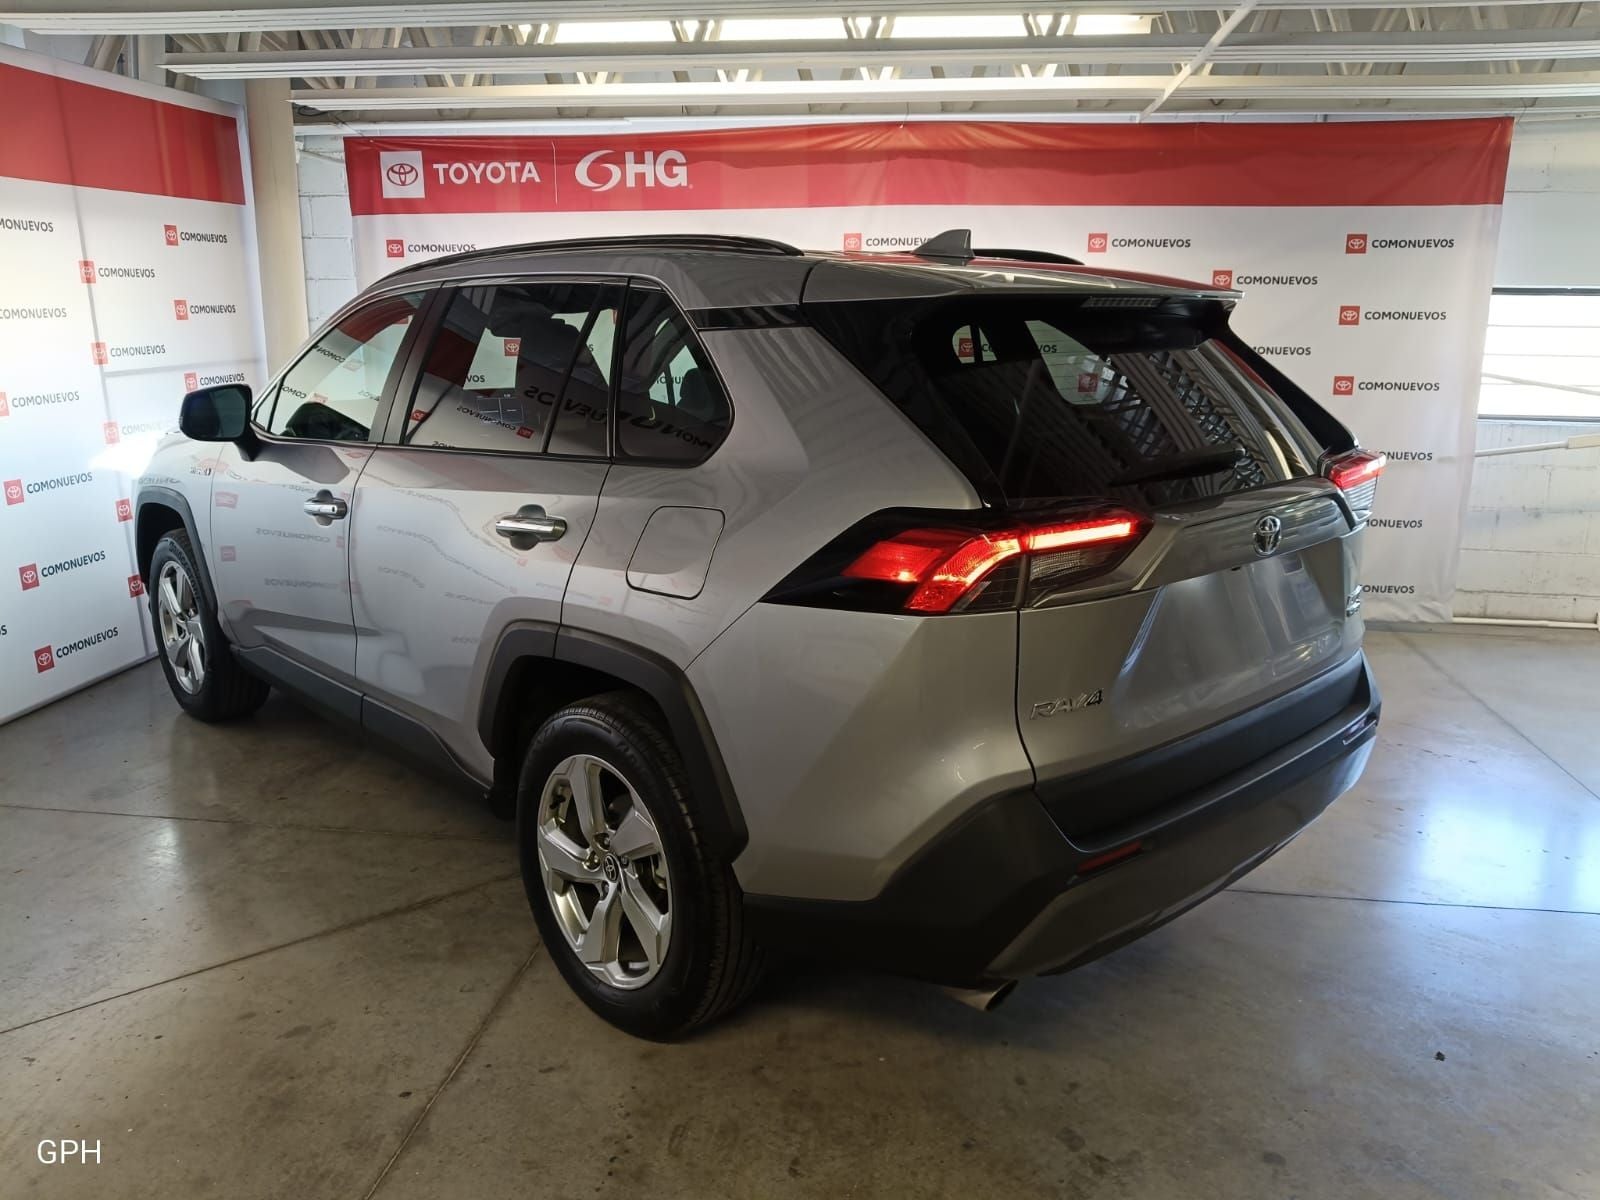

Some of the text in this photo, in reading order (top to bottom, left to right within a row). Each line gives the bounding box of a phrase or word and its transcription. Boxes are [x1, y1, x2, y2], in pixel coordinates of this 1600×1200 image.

[433, 161, 541, 185] TOYOTA
[180, 232, 227, 244] COMONUEVOS
[866, 237, 936, 247] COMONUEV
[1112, 239, 1191, 249] COMONUEVOS
[1372, 239, 1454, 249] COMONUEVOS
[408, 244, 476, 253] COMONUEVOS
[98, 267, 155, 279] COMONUEVOS
[1237, 275, 1318, 286] COMONUEVOS
[190, 304, 236, 315] COMONUEVOS
[1365, 311, 1447, 321] COMONUEVOS
[111, 345, 165, 357] COMONUEVOS
[200, 373, 245, 385] COMONUEVOS
[1358, 381, 1440, 392] COMONUEVOS
[12, 391, 80, 408] COMONUEVOS
[27, 472, 93, 494] COMONUEVOS
[42, 551, 106, 578] COMONUEVOS
[1361, 585, 1415, 594] ONUEVOS
[56, 626, 119, 658] COMONUEVOS
[1029, 688, 1104, 720] RAV4
